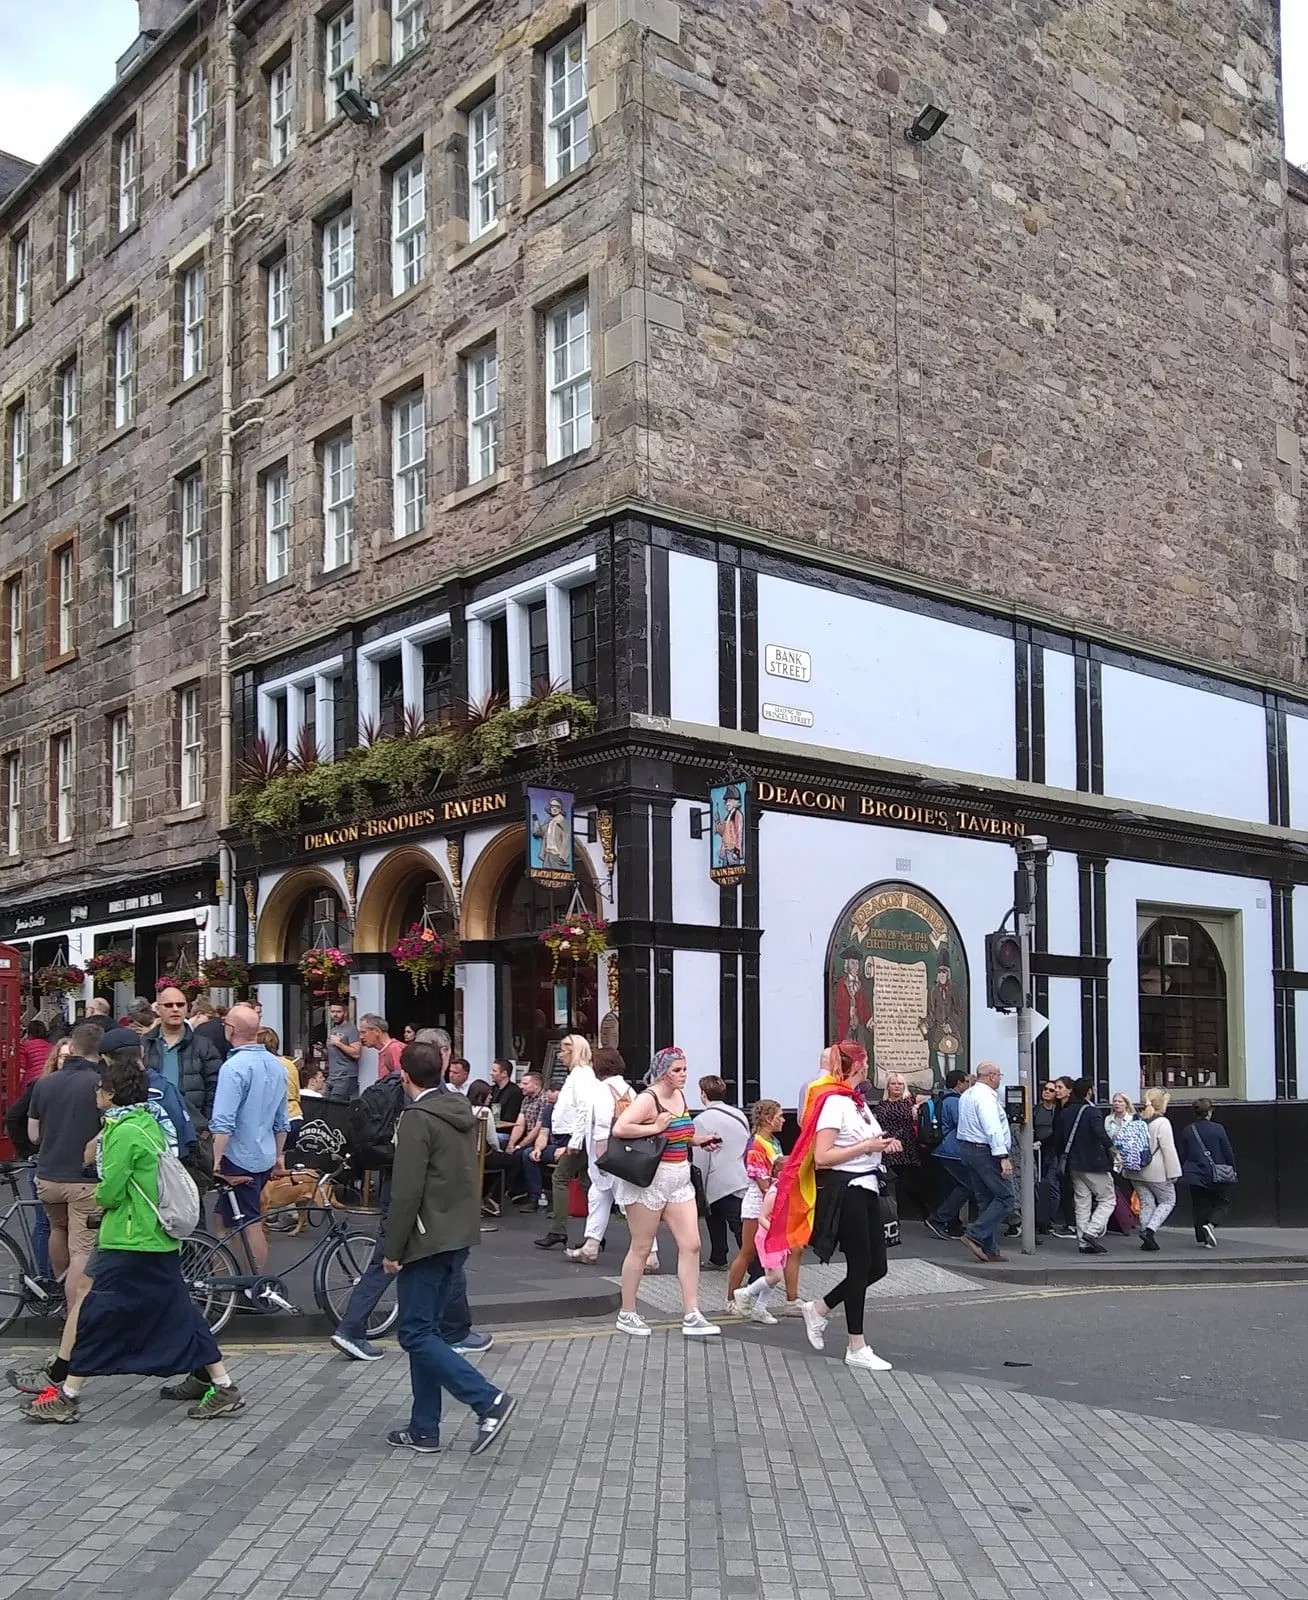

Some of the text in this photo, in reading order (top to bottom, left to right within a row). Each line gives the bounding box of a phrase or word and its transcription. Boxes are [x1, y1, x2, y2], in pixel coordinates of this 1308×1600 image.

[770, 661, 807, 679] STREET
[775, 649, 802, 666] BANK
[765, 711, 811, 725] PRINCES STREET
[757, 781, 1026, 837] DEACON BRODIE'S TAVERN
[304, 827, 359, 851] DEACON
[441, 793, 508, 821] TAVERN
[852, 892, 904, 925] DEACON
